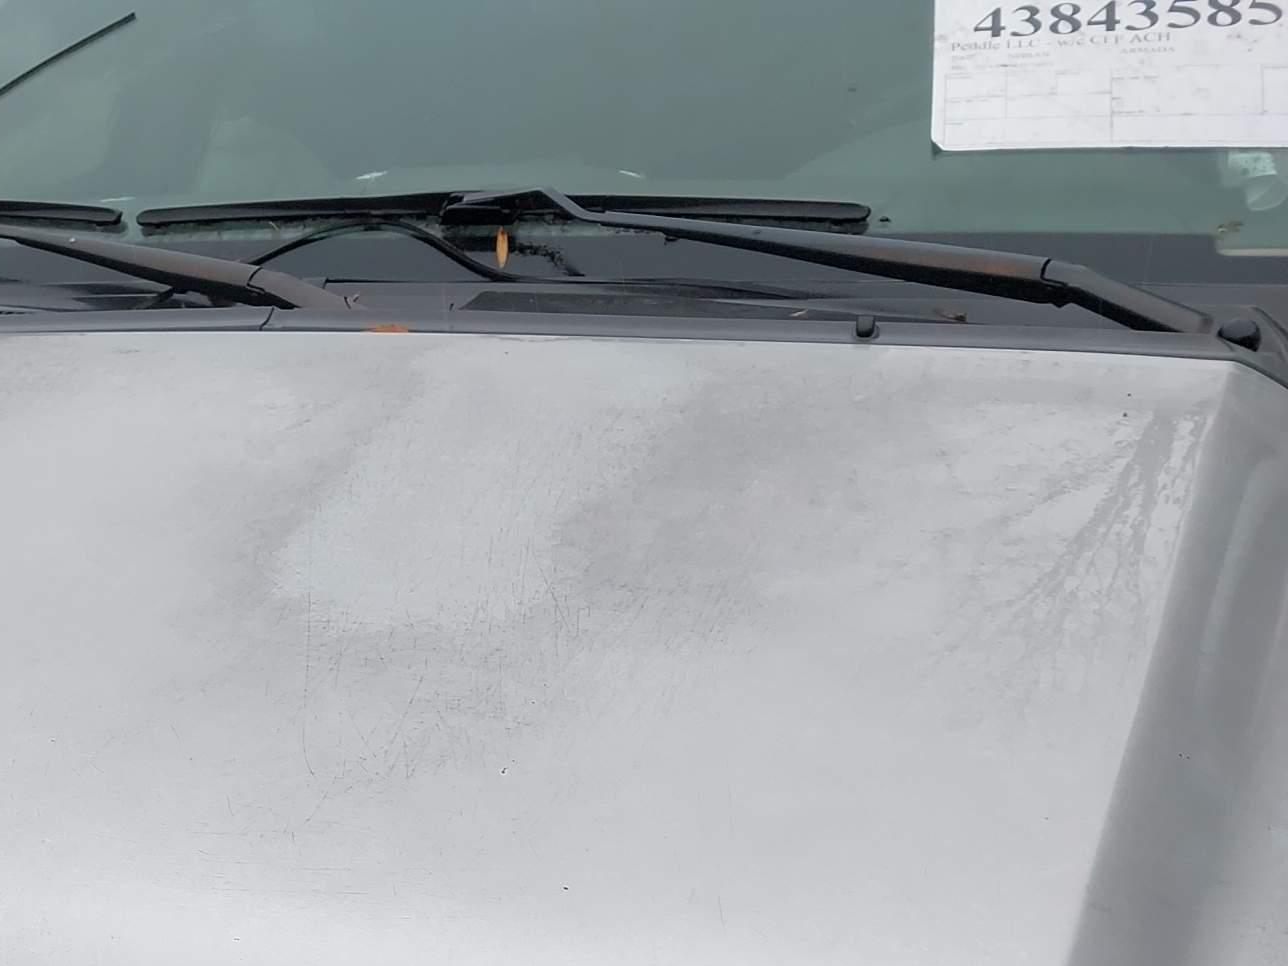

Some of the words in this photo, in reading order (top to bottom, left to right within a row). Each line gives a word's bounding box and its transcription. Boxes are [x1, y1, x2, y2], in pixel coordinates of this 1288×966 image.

[972, 0, 1283, 38] 43843585
[951, 41, 1001, 52] Peddle
[1007, 39, 1040, 49] LLC
[1129, 32, 1171, 43] ACH
